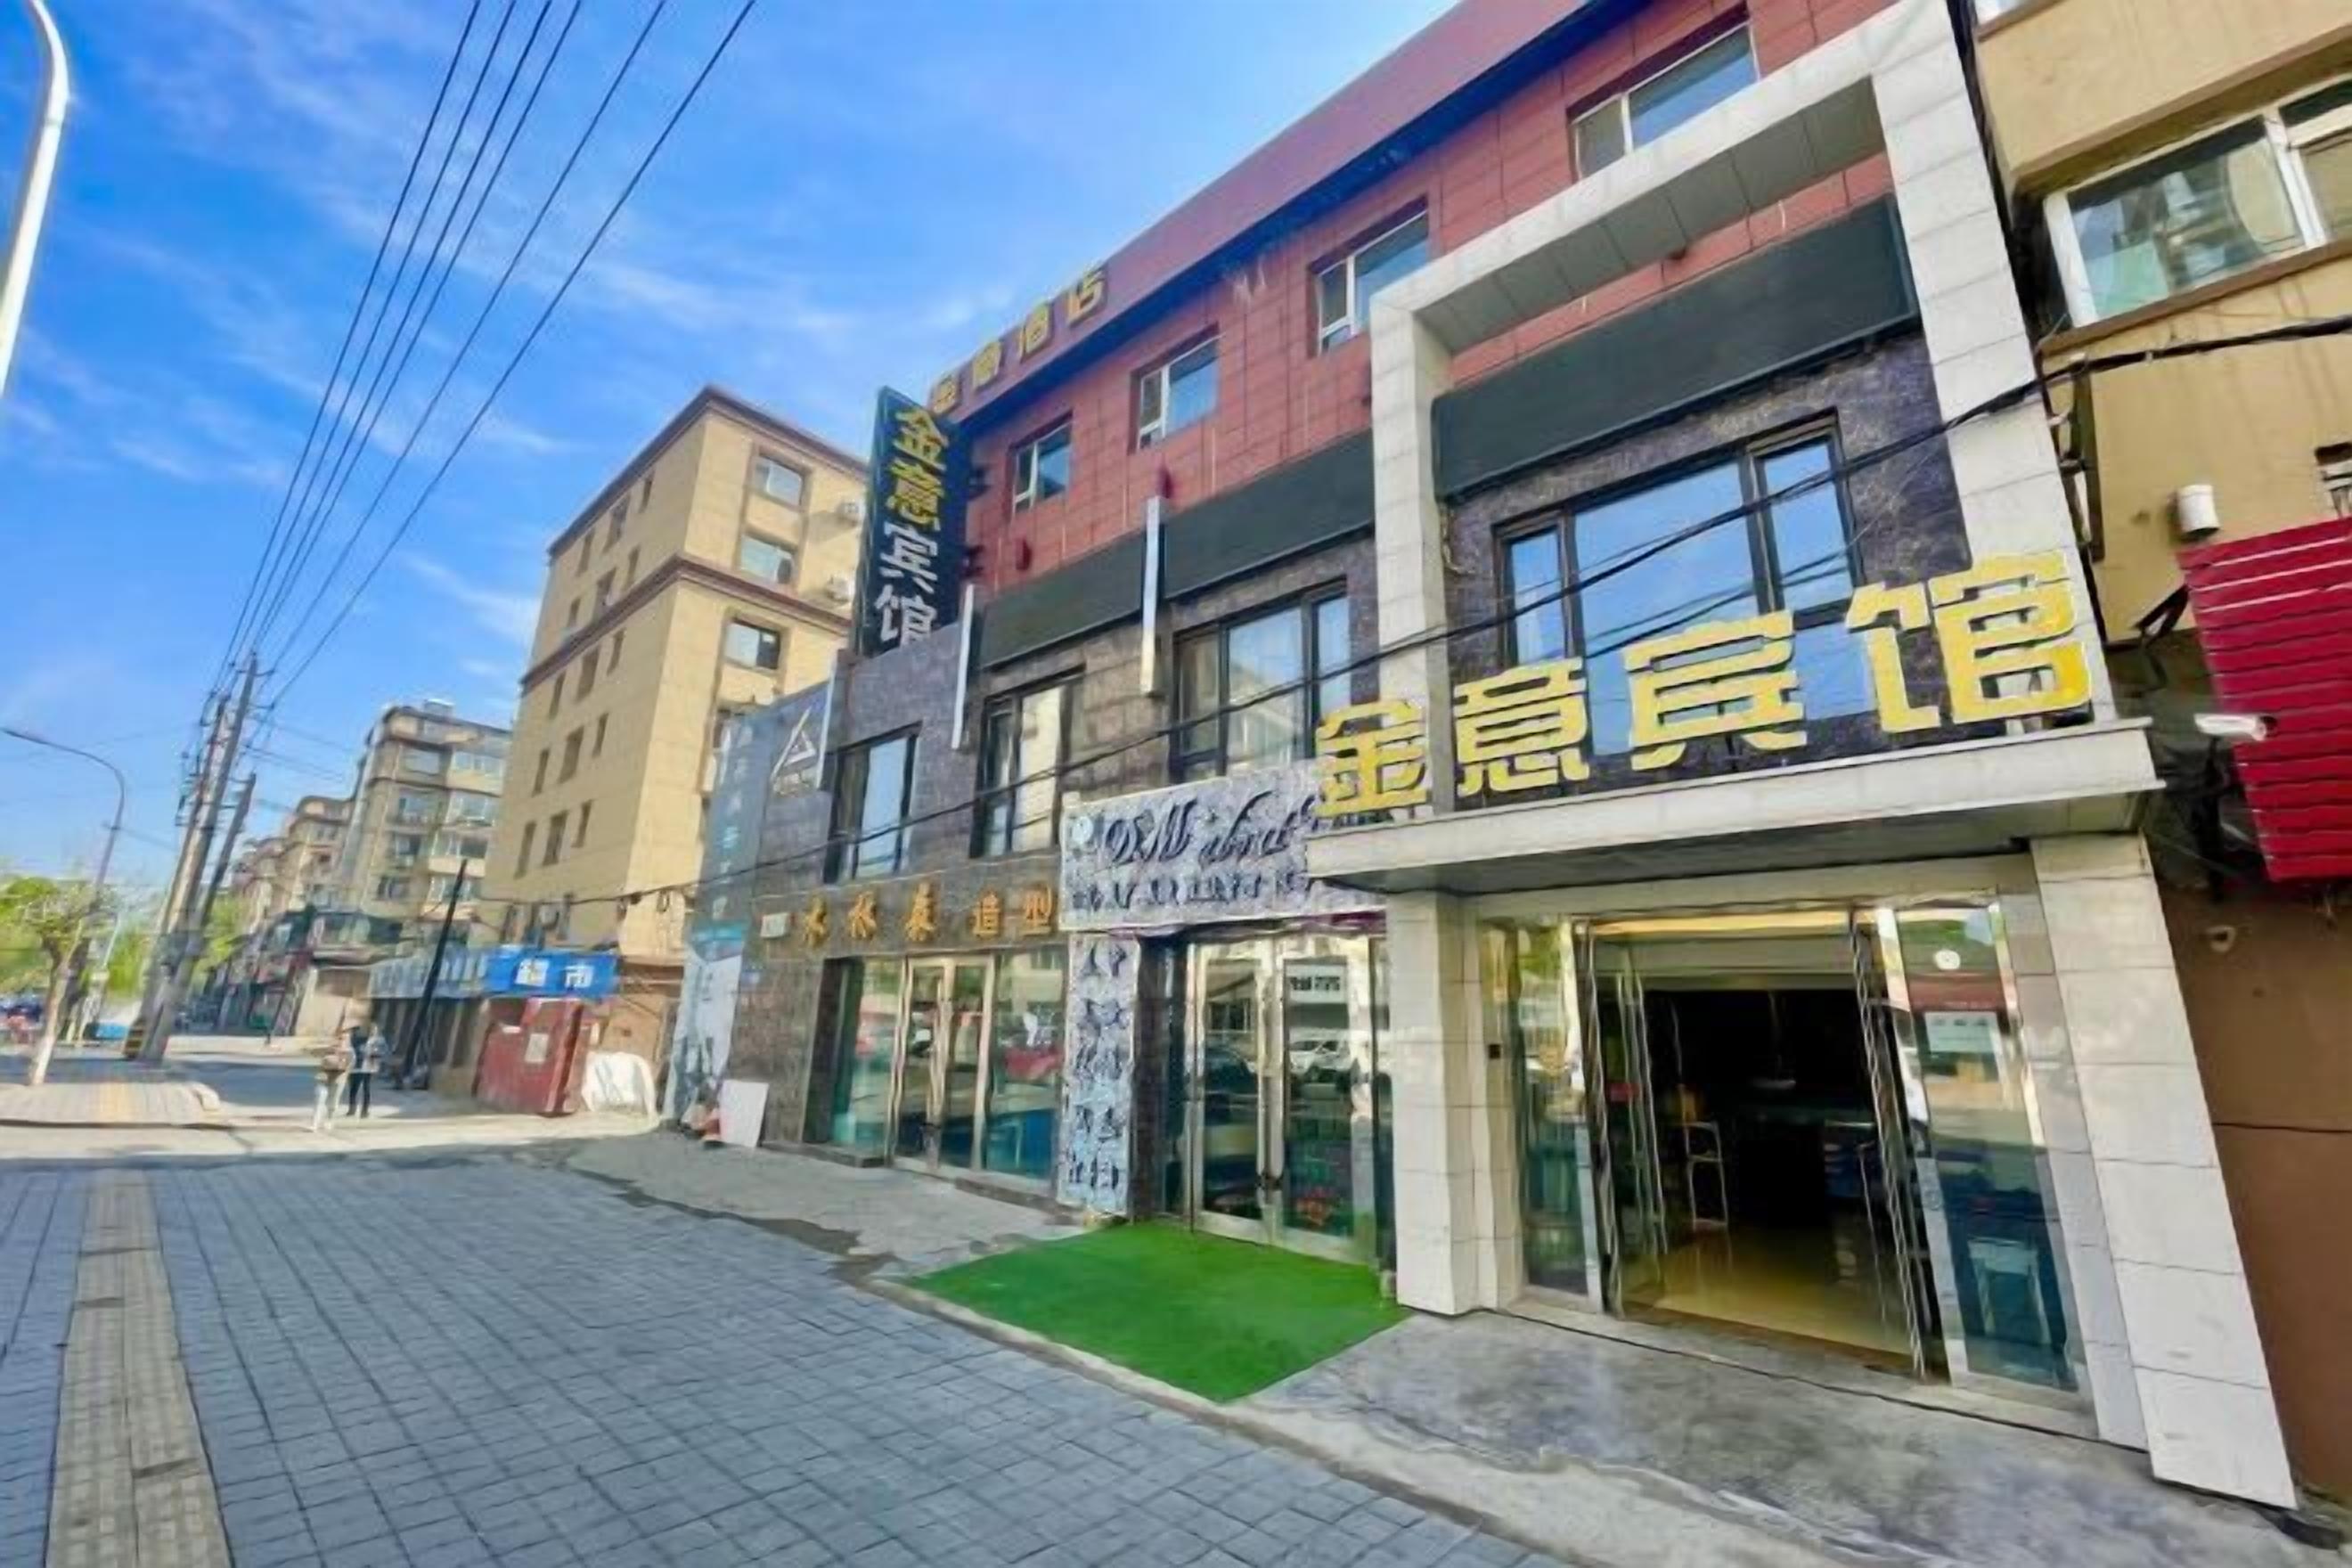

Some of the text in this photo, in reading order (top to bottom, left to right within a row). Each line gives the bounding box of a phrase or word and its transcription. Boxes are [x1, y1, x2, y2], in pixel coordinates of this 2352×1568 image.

[875, 407, 948, 646] 金意宾馆
[1314, 551, 2094, 818] 金意宾馆
